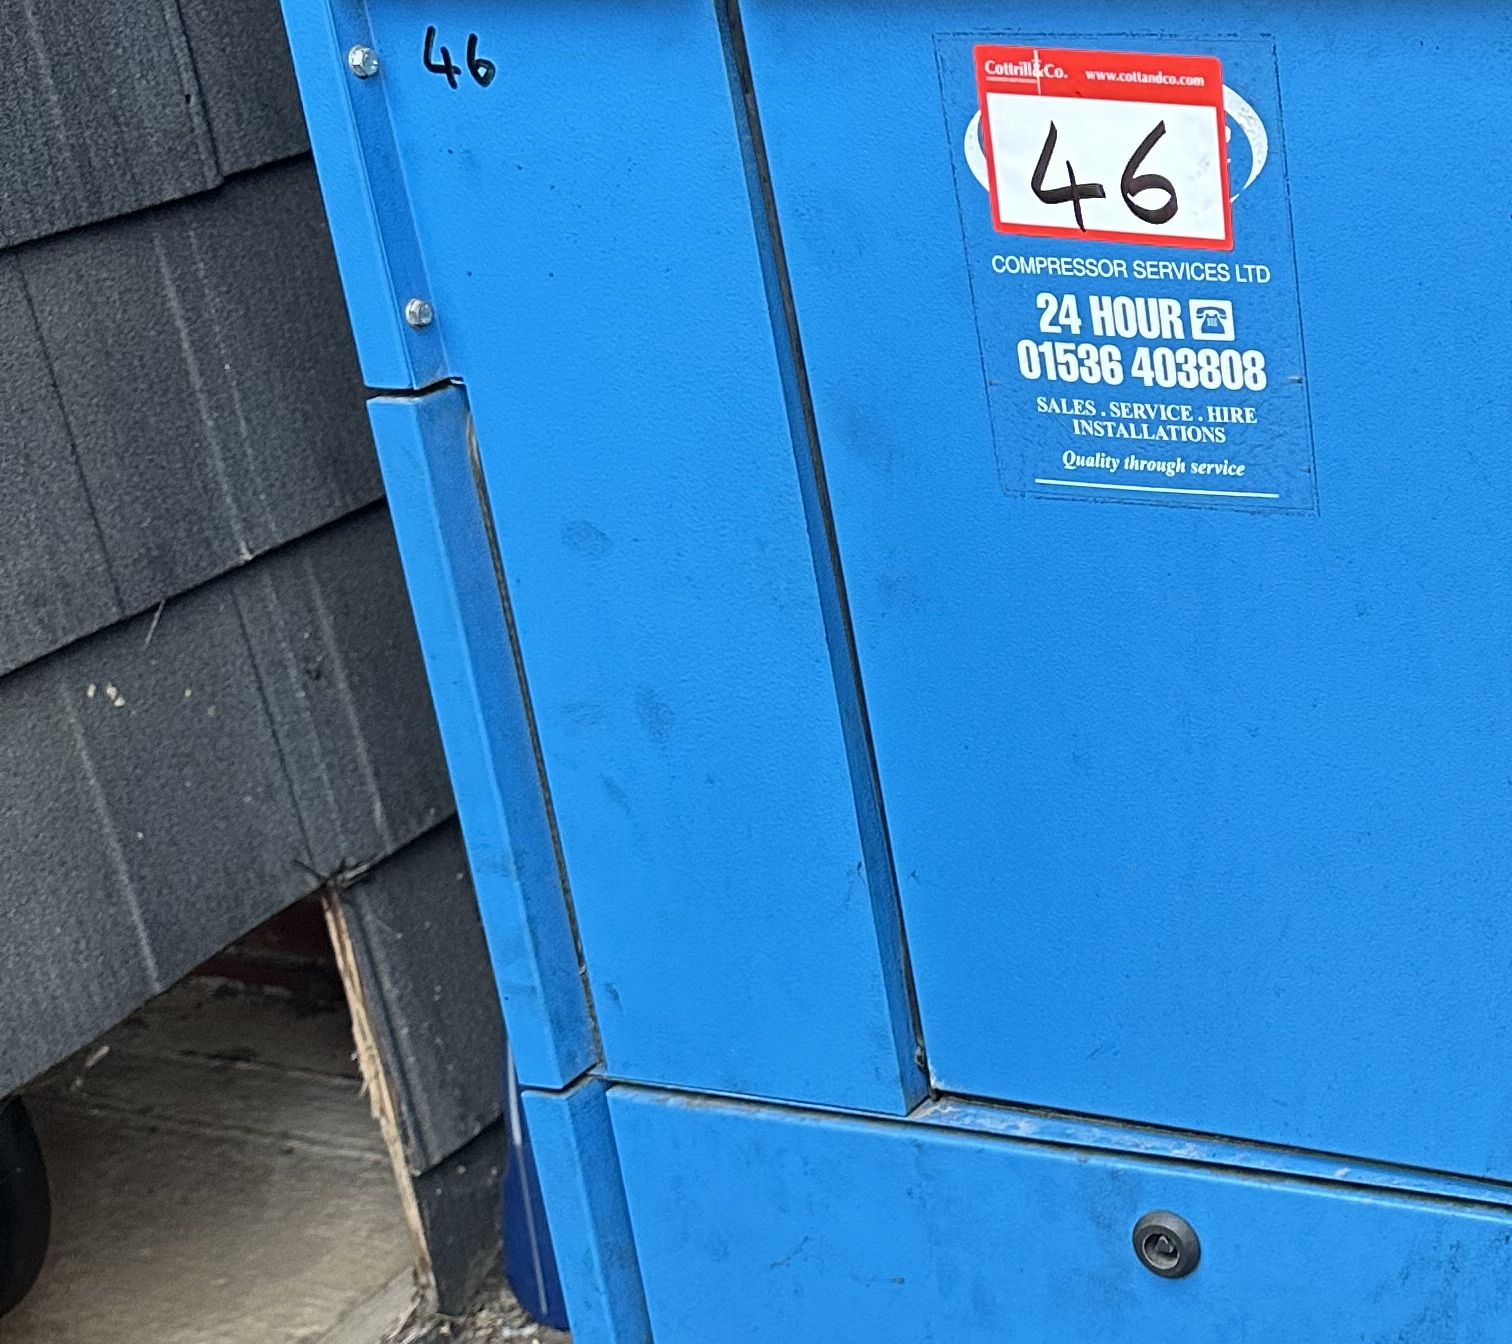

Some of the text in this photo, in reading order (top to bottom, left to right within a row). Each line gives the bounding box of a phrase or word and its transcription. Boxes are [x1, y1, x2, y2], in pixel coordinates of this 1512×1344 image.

[424, 25, 496, 89] 46
[1085, 69, 1205, 87] www.cottandco.com
[1031, 120, 1178, 233] 46
[991, 254, 1271, 284] COMPRESSOR SERVICES LTD
[1036, 292, 1185, 340] 24 HOUR
[1017, 339, 1267, 391] 01536 403808
[1036, 396, 1097, 417] SALES
[1109, 401, 1192, 422] SERVICE
[1207, 406, 1258, 424] HIRE
[1072, 419, 1227, 443] INSTALLATIONS
[1062, 450, 1246, 477] Quality through service
